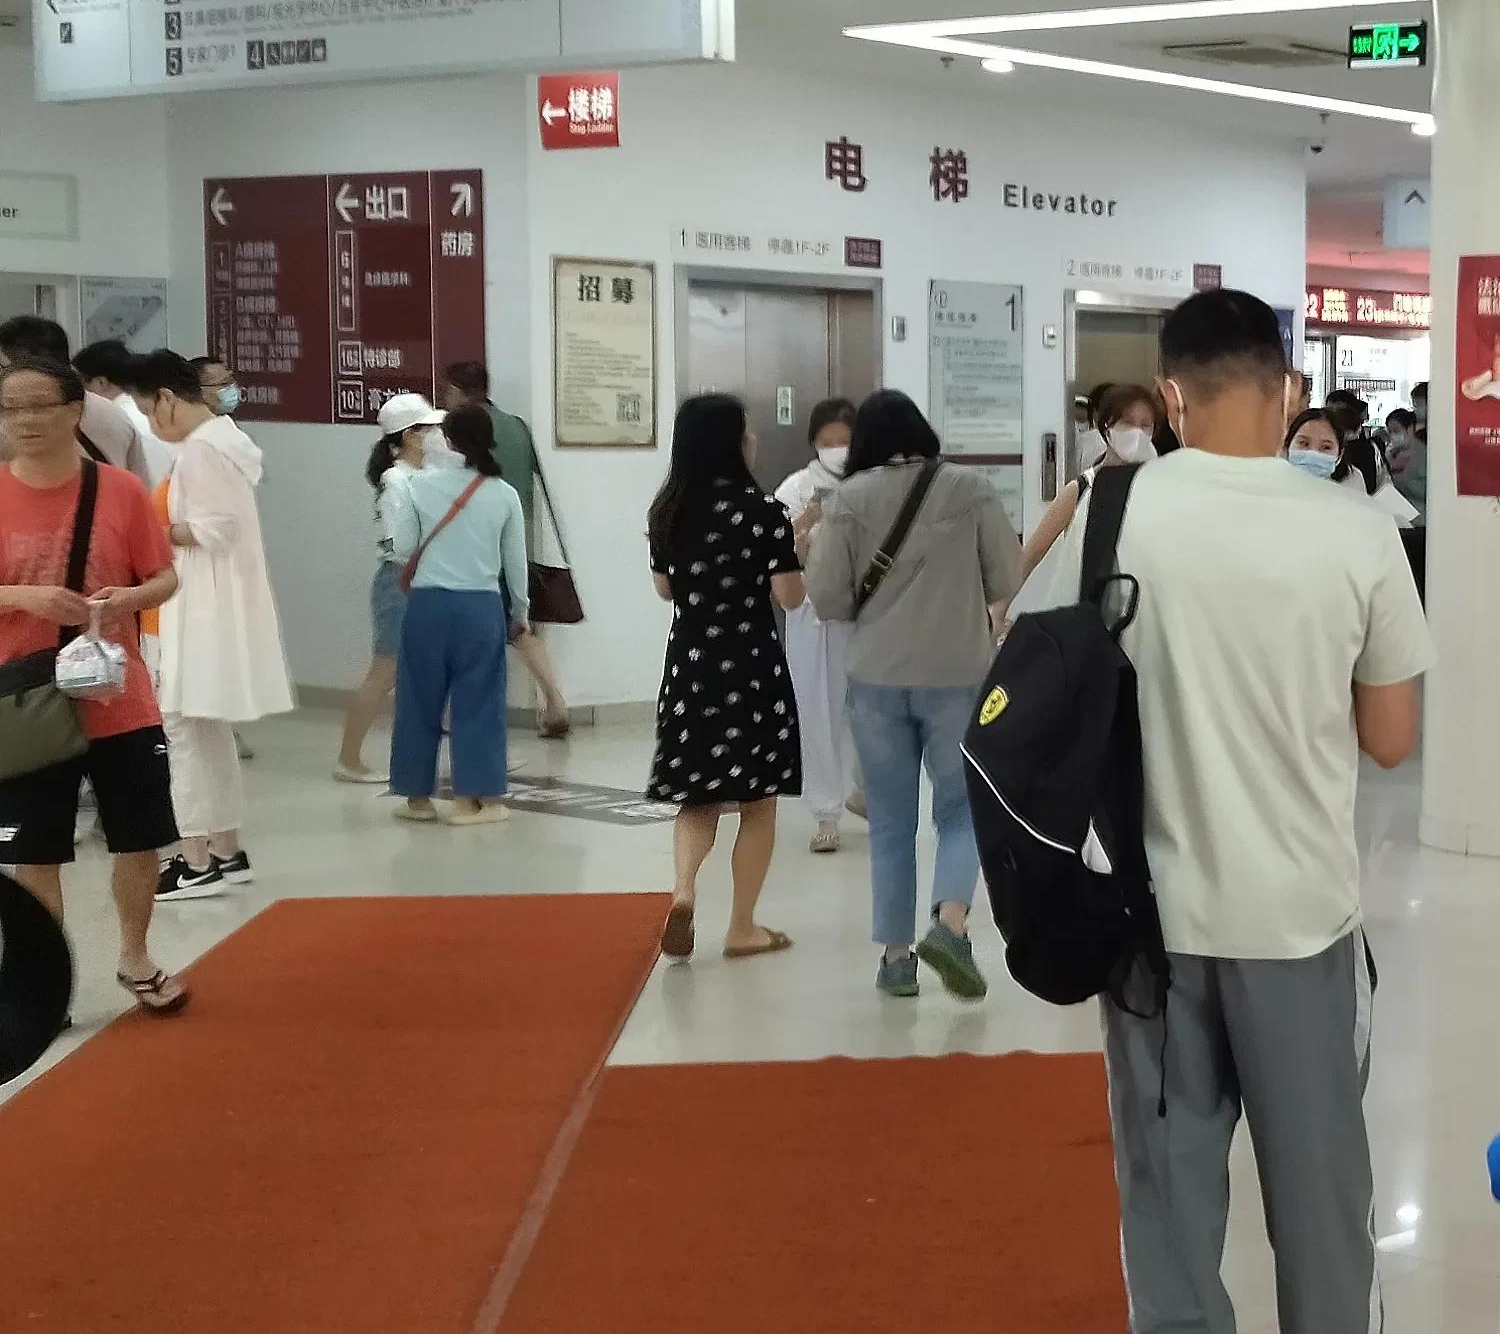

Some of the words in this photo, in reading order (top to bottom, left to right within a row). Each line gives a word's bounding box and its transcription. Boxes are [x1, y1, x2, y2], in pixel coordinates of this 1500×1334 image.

[567, 85, 613, 121] 楼梯
[365, 185, 408, 219] 出口
[1003, 183, 1118, 218] Elevator
[440, 231, 473, 256] 药房
[577, 273, 634, 305] 招募
[1005, 294, 1016, 331] 1
[1356, 295, 1374, 322] 23
